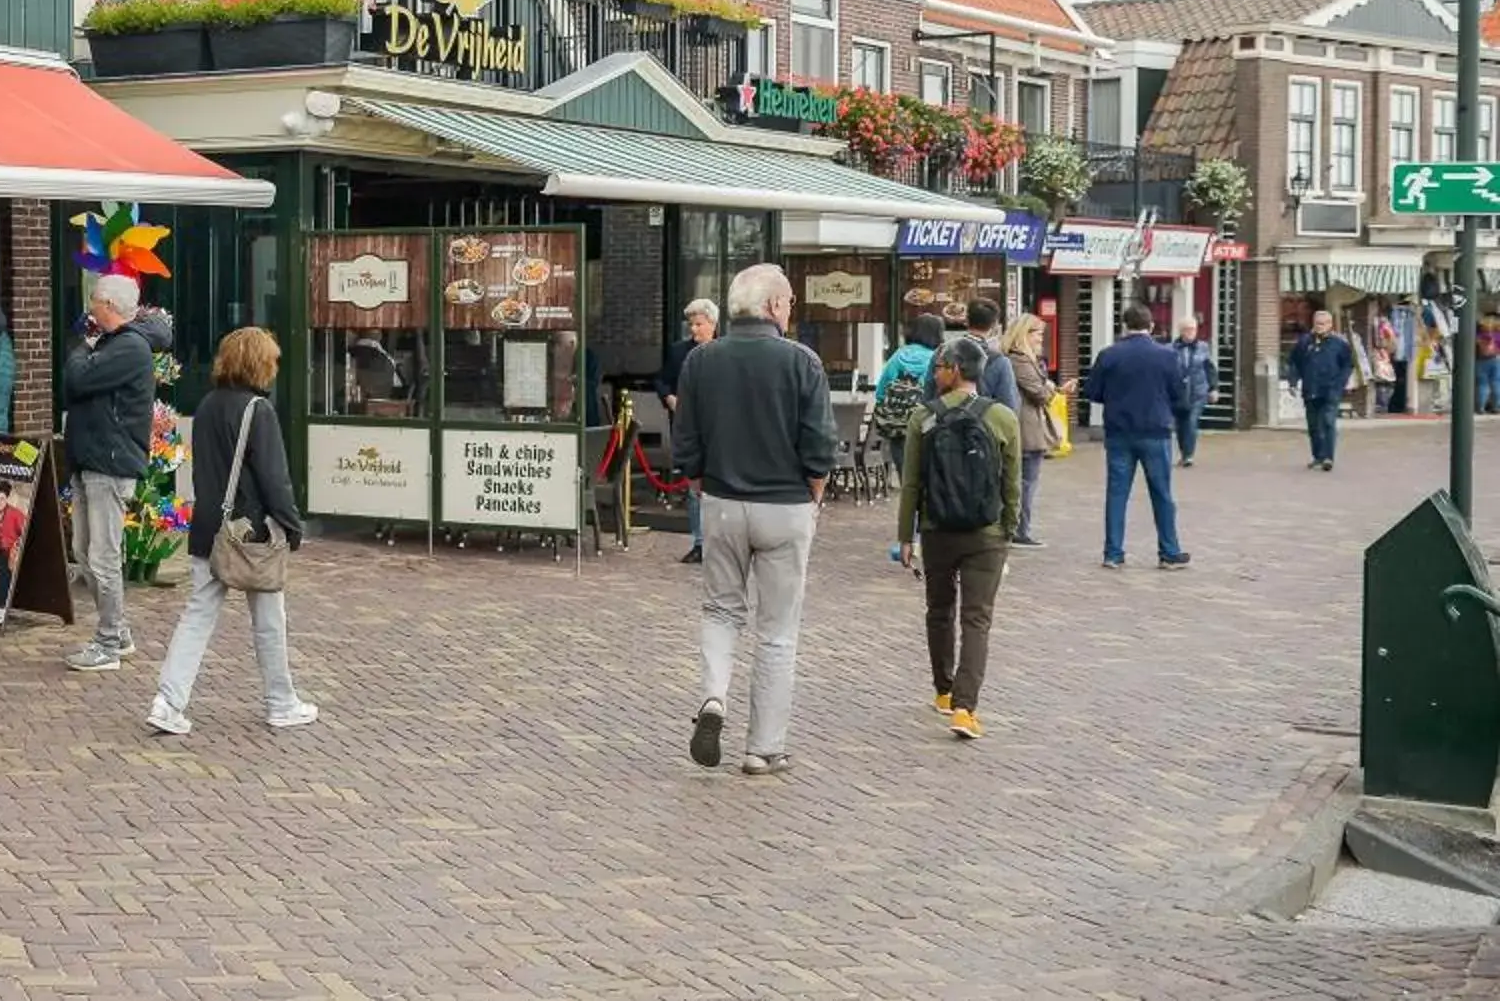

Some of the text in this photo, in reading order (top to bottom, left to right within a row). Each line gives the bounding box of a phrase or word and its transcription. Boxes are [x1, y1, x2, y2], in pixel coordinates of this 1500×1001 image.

[384, 4, 525, 81] De Vrijheid
[758, 78, 837, 124] Heineken
[905, 219, 1030, 251] TICKET OFFICE
[464, 442, 555, 464] Fish & chips
[467, 460, 552, 479] Sandwiches
[483, 478, 534, 496] Snacks
[475, 495, 541, 514] Pancakes
